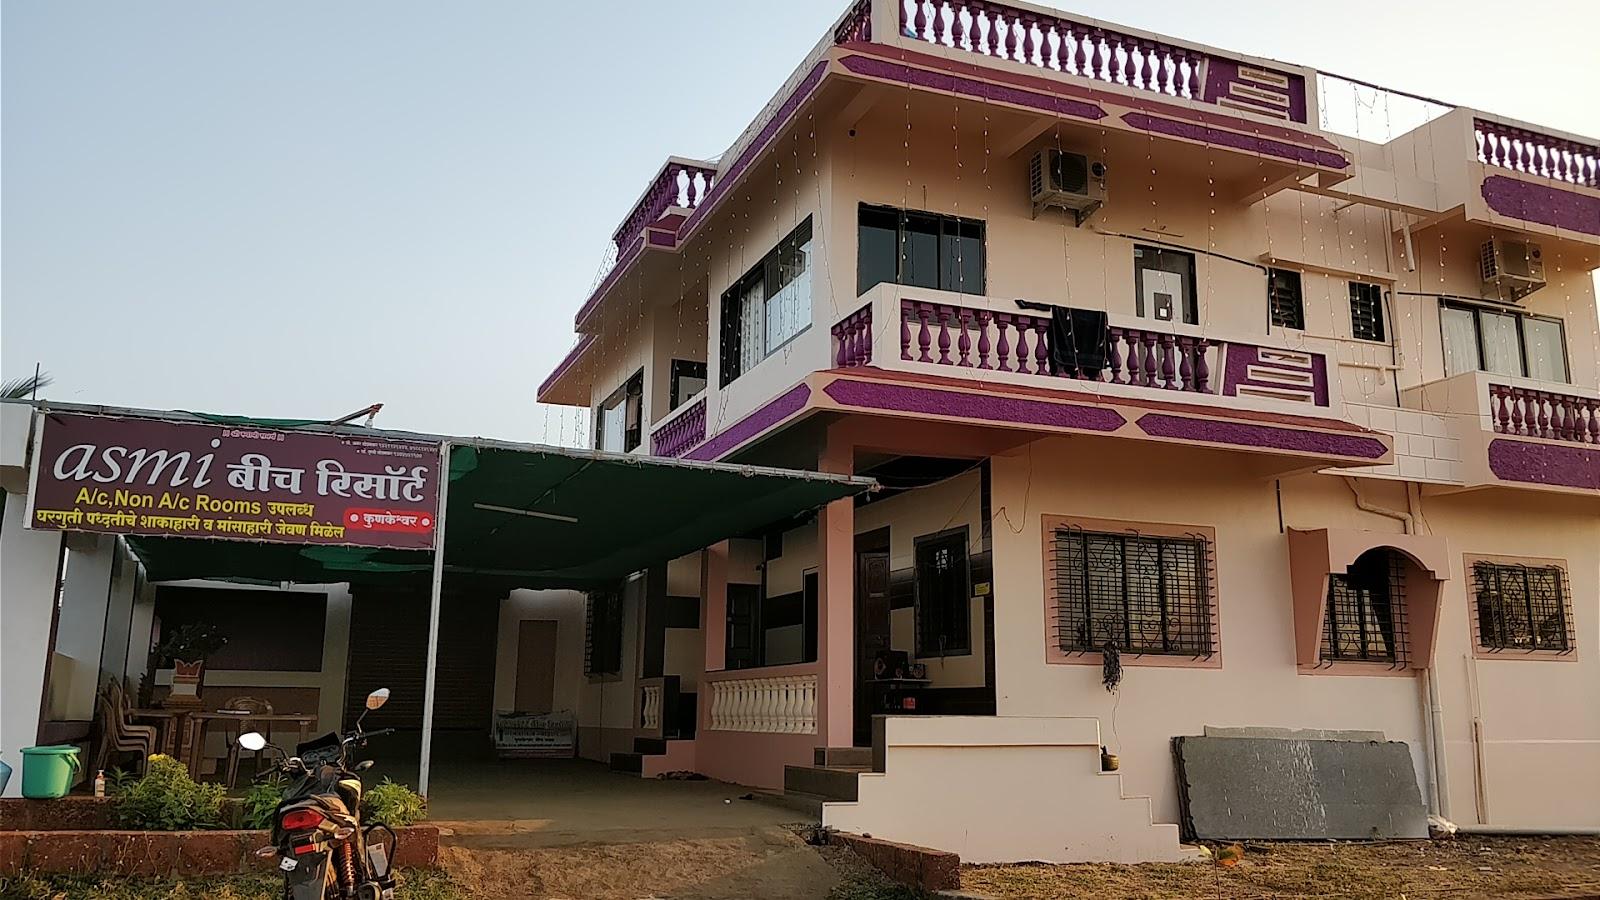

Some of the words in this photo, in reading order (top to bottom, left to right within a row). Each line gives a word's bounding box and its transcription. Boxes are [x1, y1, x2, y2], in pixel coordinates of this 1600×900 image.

[53, 438, 221, 489] asmi
[226, 453, 305, 494] बीच
[315, 459, 429, 502] रिसॉर्ट
[158, 492, 190, 509] A/c
[196, 494, 261, 515] Rooms
[267, 501, 315, 517] उपलब्ध
[36, 507, 83, 529] घरगुती
[139, 514, 200, 532] शाकाहारी
[203, 519, 214, 531] व
[216, 516, 272, 536] मांसाहारी
[275, 519, 307, 536] जेवण
[310, 521, 345, 539] मिळेल
[363, 510, 418, 528] कुणकेश्वर
